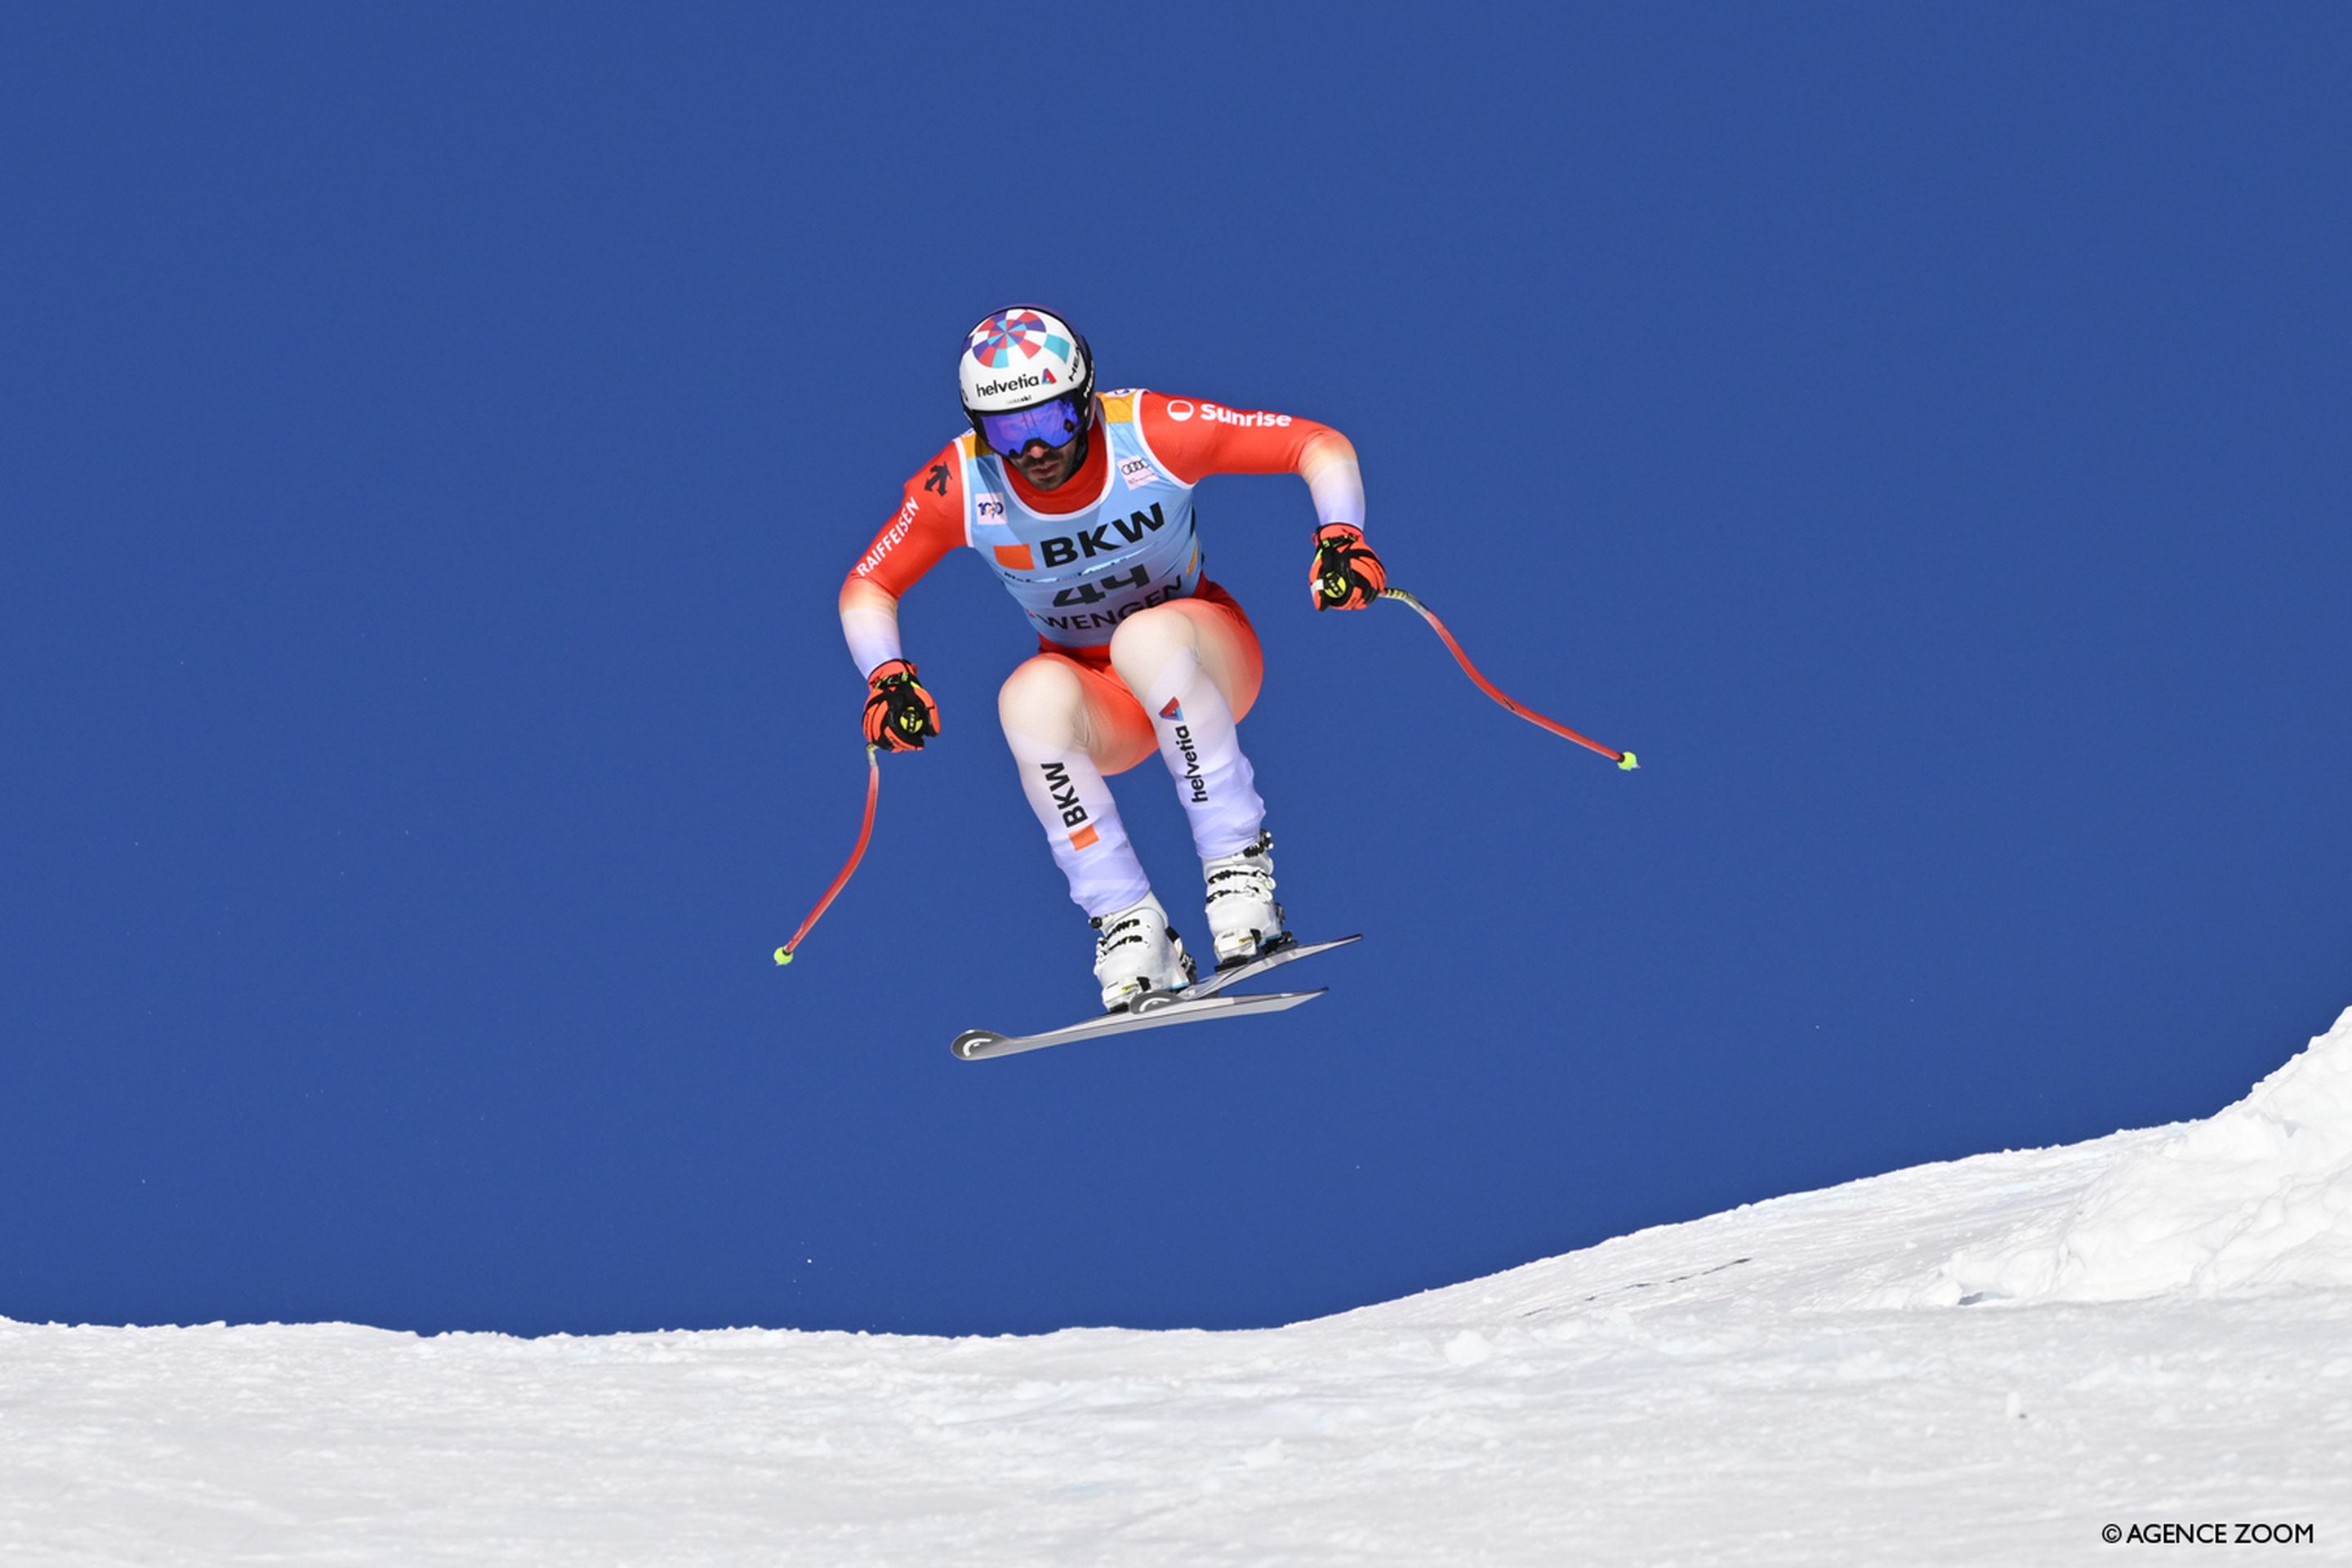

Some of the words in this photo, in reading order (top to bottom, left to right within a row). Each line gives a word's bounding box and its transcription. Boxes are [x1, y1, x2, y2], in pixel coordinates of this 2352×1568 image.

[975, 373, 1040, 398] helvetia
[1200, 403, 1293, 427] Sunrise
[855, 496, 920, 577] RAIFFEISEN
[1040, 501, 1165, 568] BKW
[1052, 564, 1151, 608] 44
[1040, 761, 1089, 828] BKW
[1174, 724, 1209, 804] helvetia
